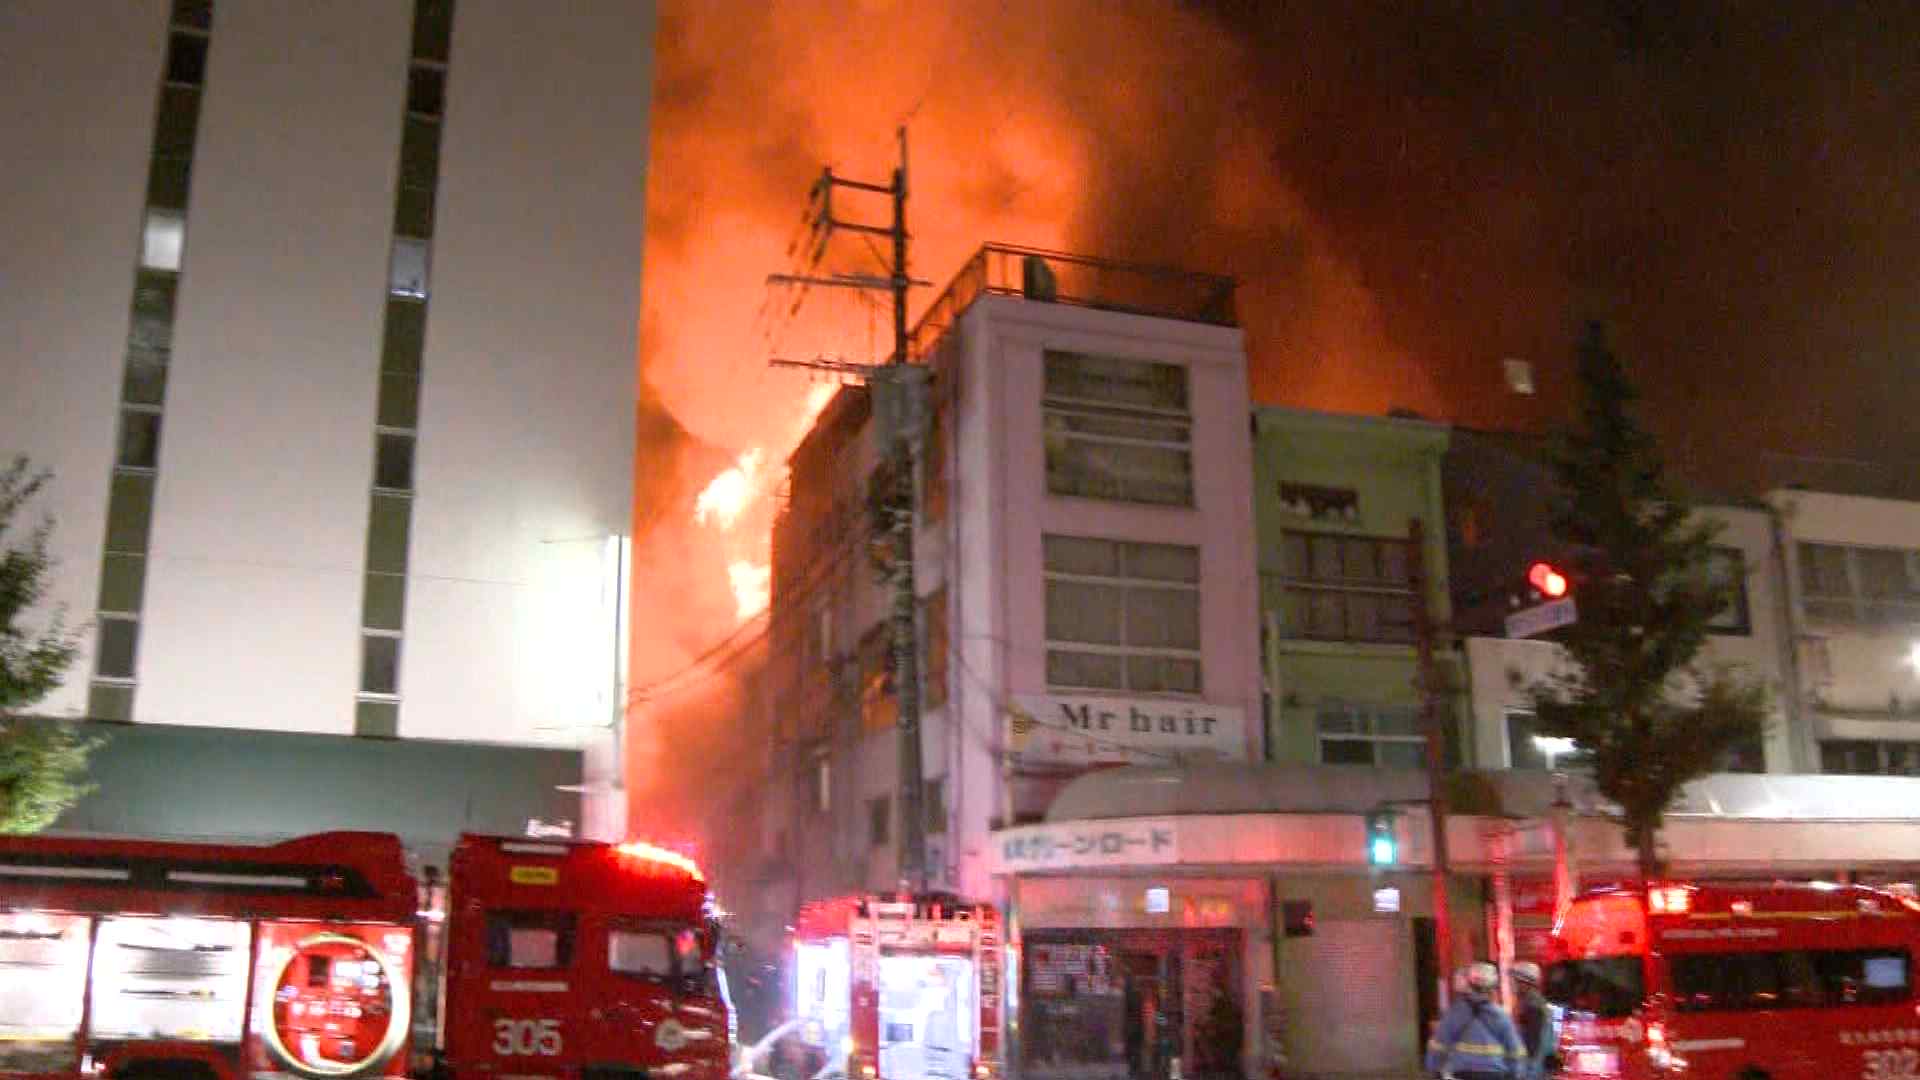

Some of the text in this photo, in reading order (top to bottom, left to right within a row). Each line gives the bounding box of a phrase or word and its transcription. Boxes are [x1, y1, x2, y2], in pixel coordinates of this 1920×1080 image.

[1059, 704, 1116, 730] Mr
[1129, 707, 1217, 735] hair
[493, 1018, 563, 1056] 305
